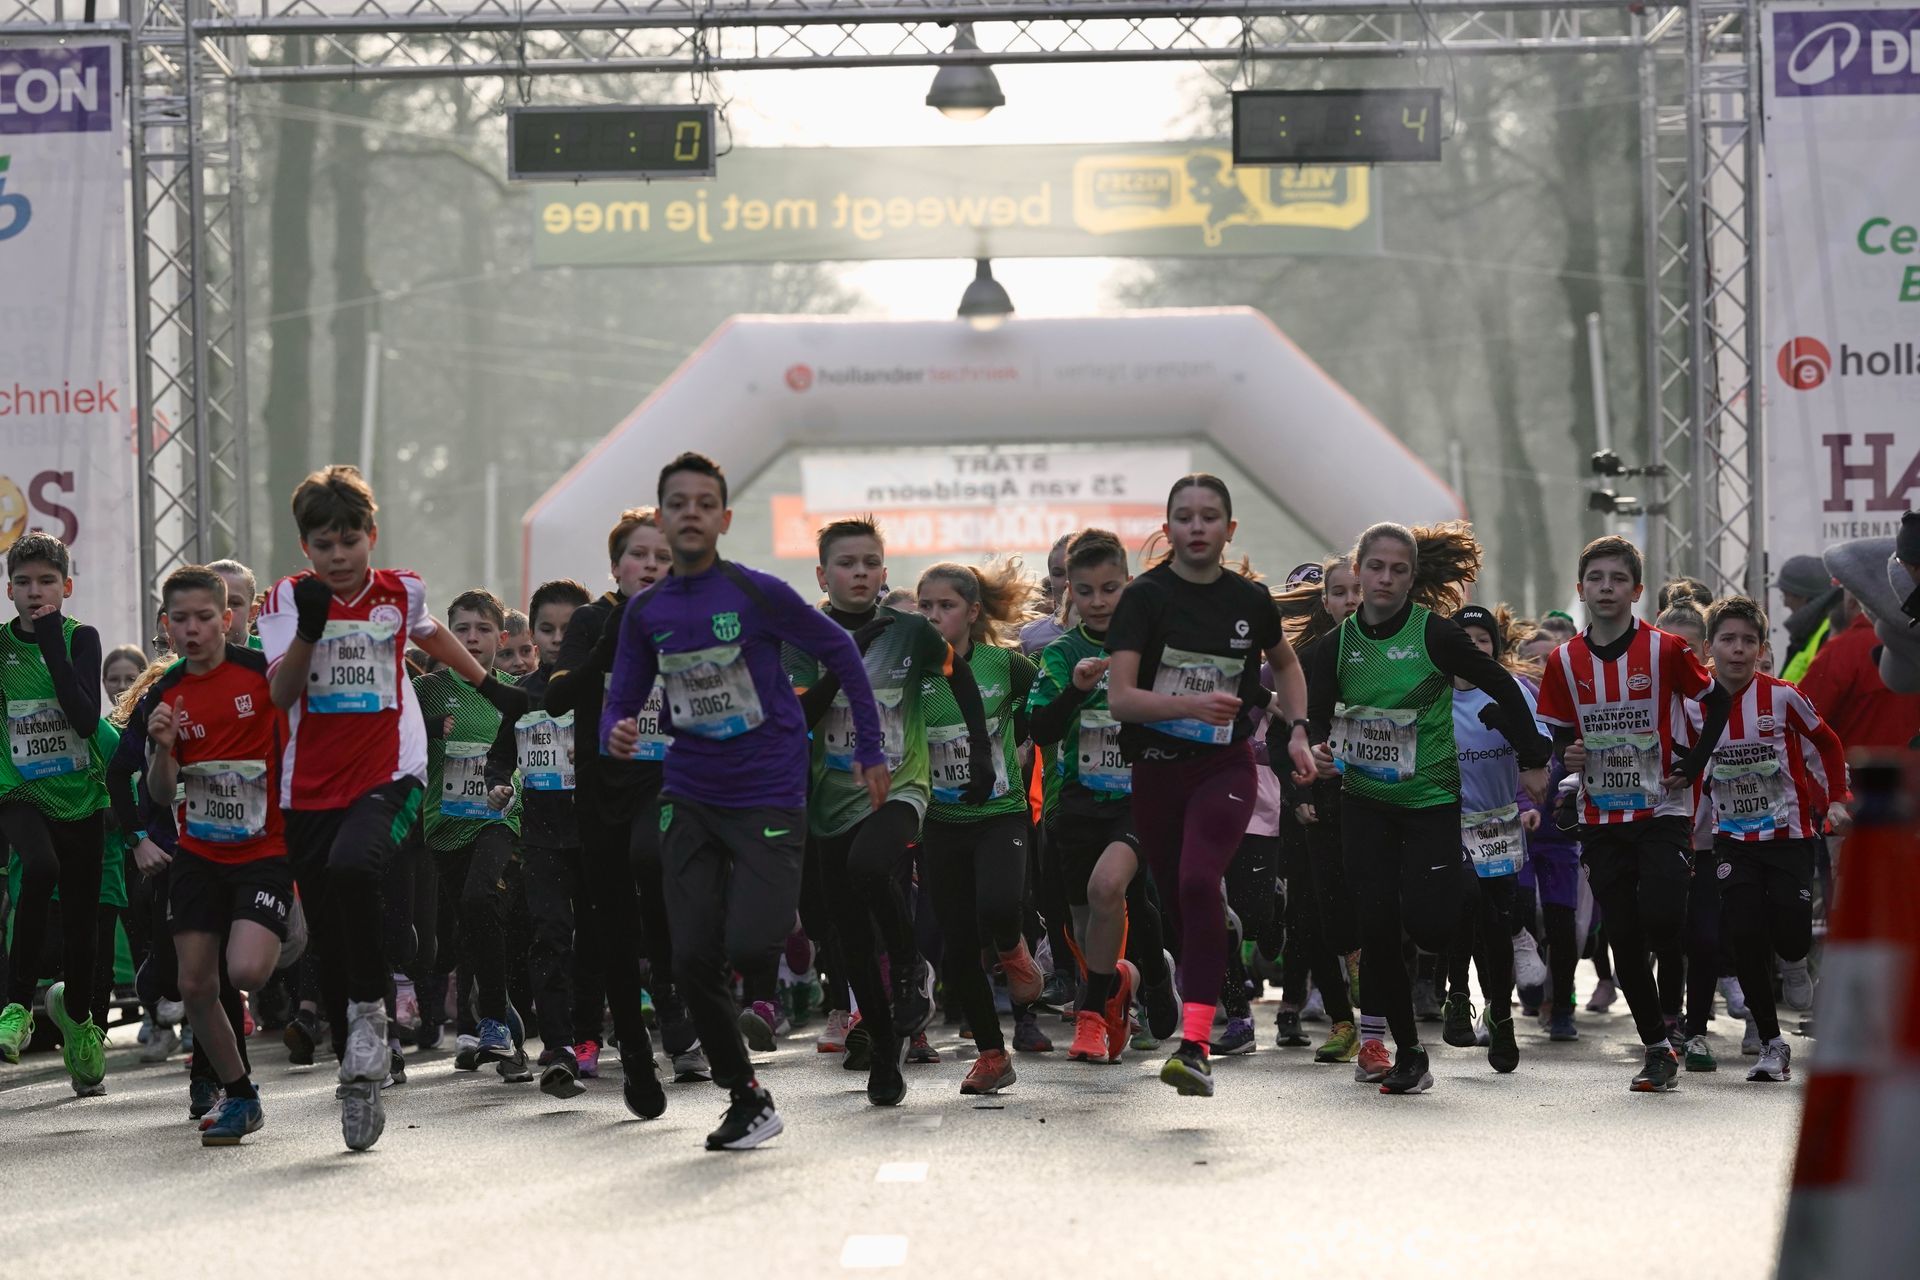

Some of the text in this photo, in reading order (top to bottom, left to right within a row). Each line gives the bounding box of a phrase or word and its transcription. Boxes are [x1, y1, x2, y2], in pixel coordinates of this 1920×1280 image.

[1857, 216, 1920, 256] Ce
[1840, 343, 1920, 376] holl
[339, 646, 366, 660] BOAZ
[329, 665, 375, 686] J3084
[1185, 676, 1215, 693] FLEUR
[690, 692, 734, 717] J3062
[1583, 709, 1649, 724] BRAINPORT
[1585, 718, 1650, 732] EINDHOVEN
[192, 724, 206, 739] 10
[532, 733, 552, 745] MEES
[1363, 728, 1391, 741] SUZAN
[27, 736, 67, 757] J3025
[1356, 742, 1399, 762] M3293
[1458, 744, 1513, 763] ofpeople
[527, 750, 557, 767] J3031
[1607, 755, 1633, 768] JURRE
[1602, 772, 1640, 788] J3078
[210, 783, 237, 797] PELLE
[204, 799, 244, 820] J3080
[1733, 796, 1769, 814] J3079
[1477, 829, 1499, 840] DAAN
[254, 891, 286, 917] PM 10
